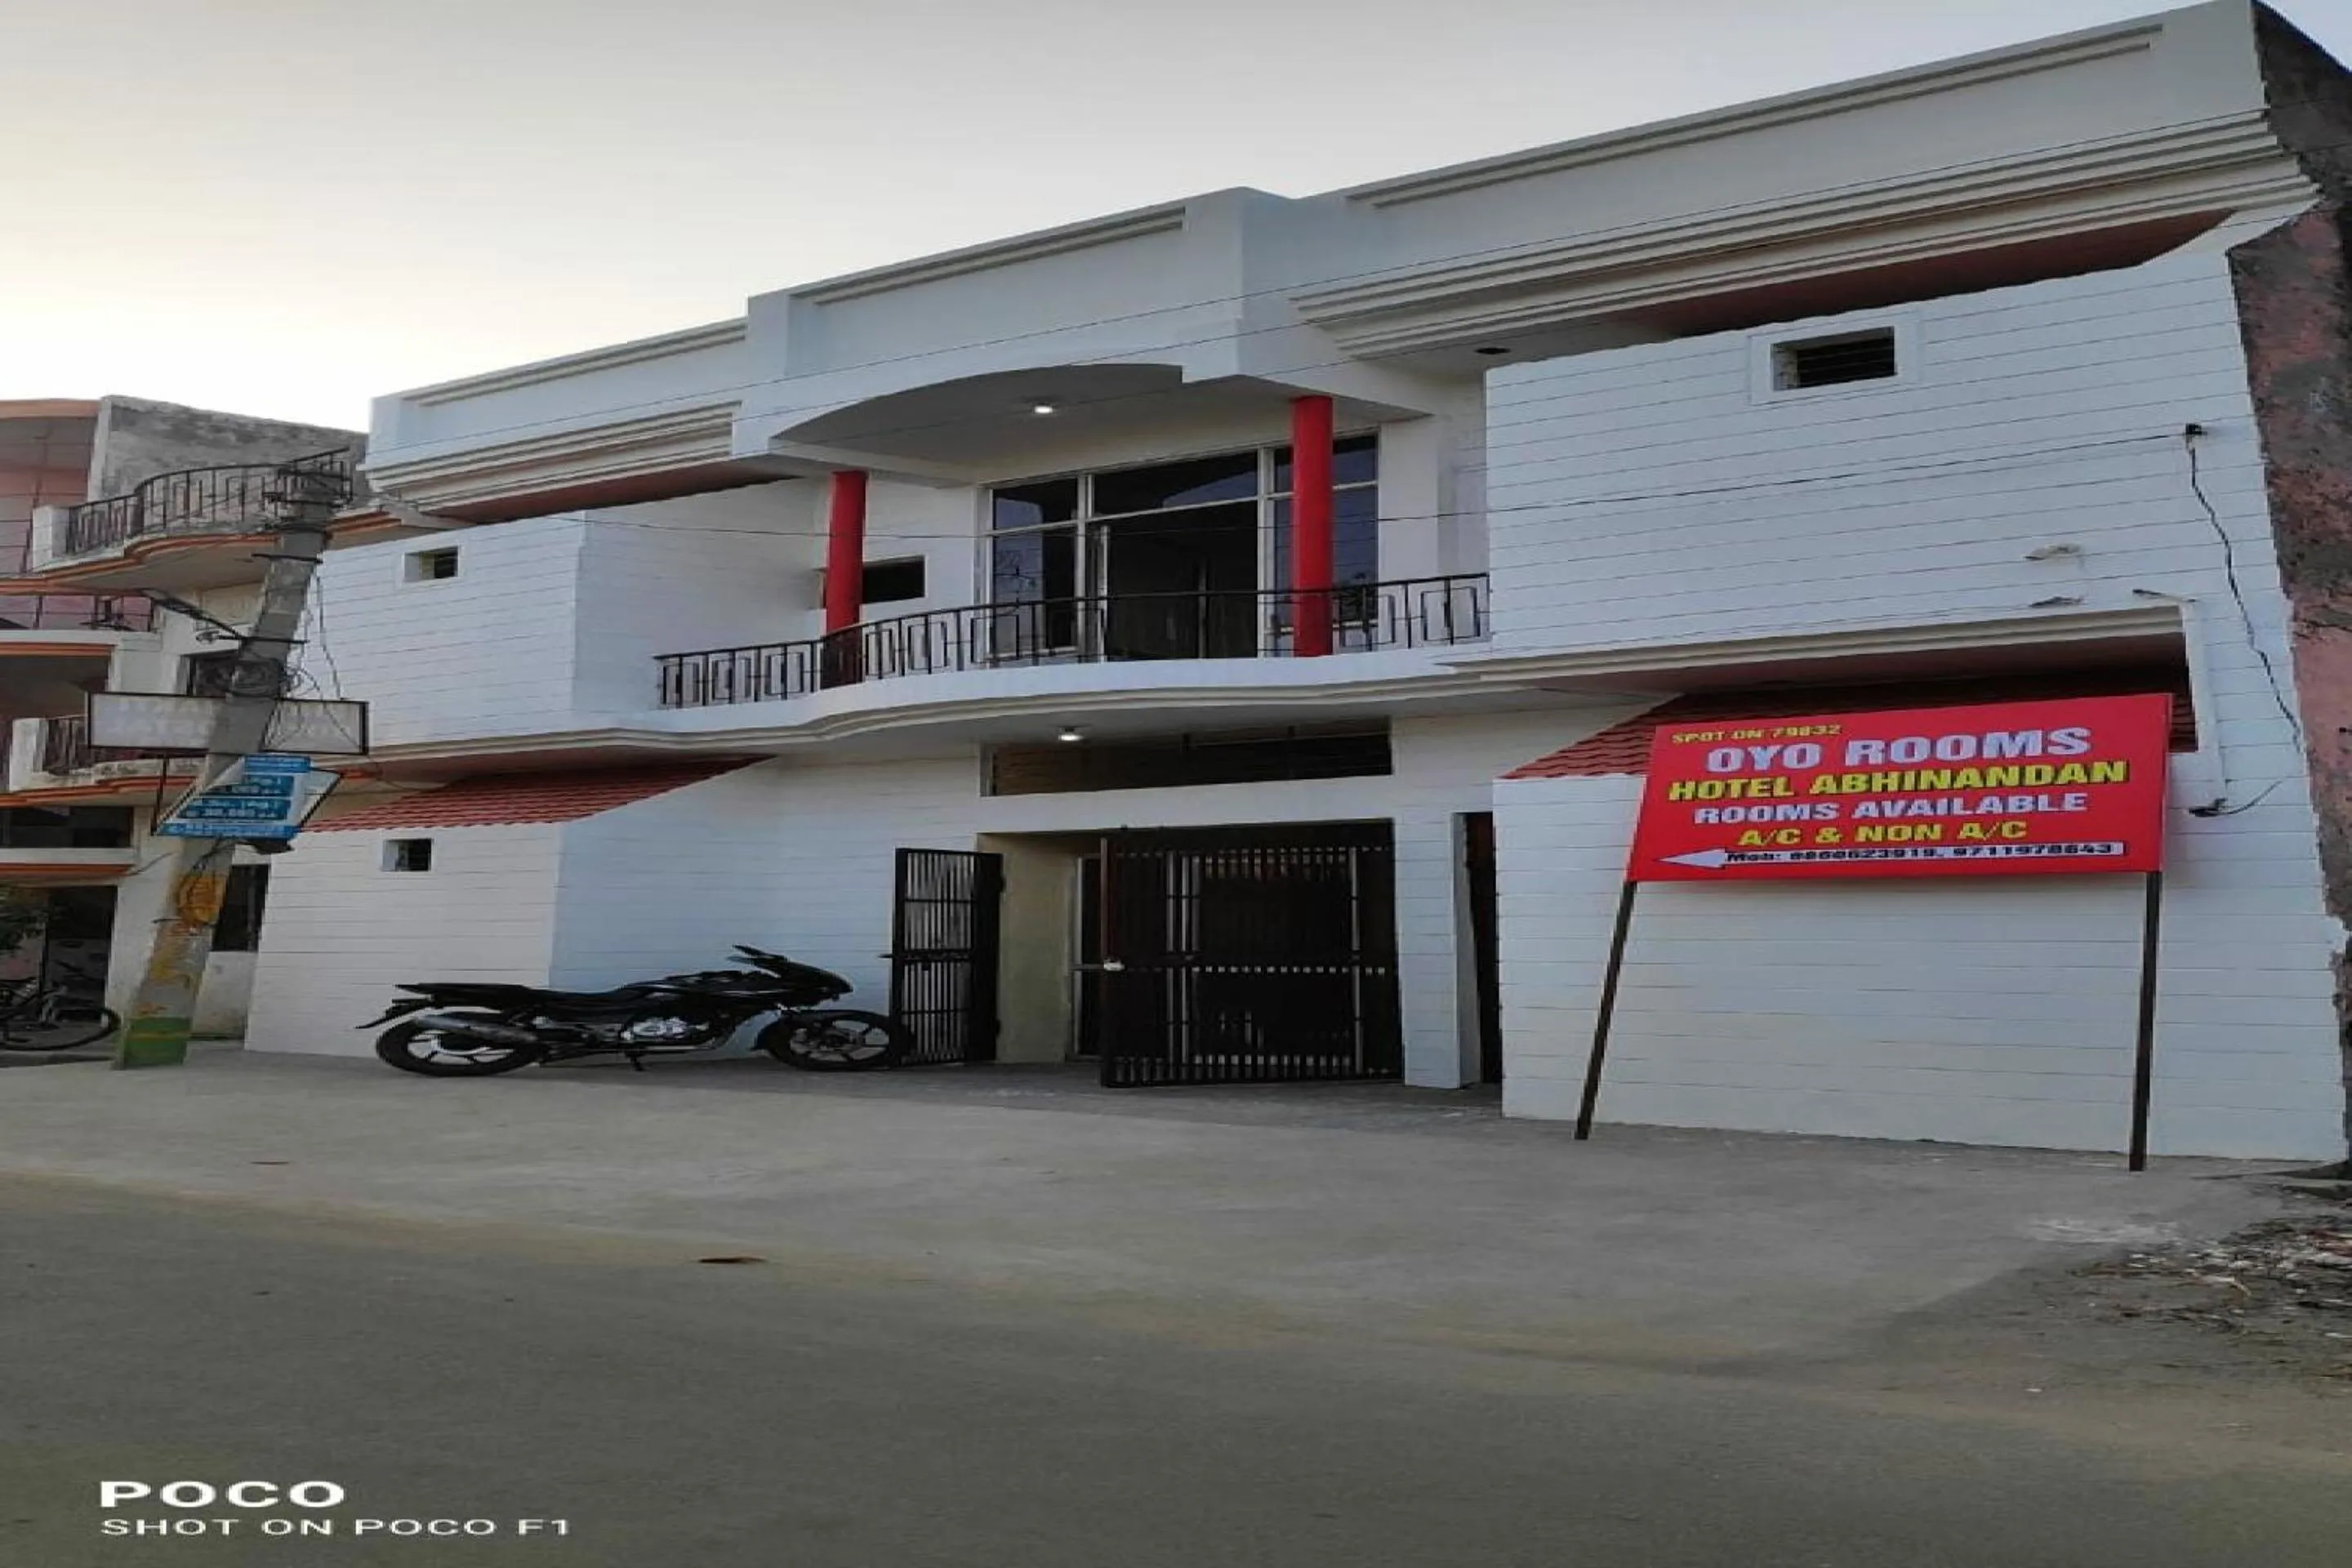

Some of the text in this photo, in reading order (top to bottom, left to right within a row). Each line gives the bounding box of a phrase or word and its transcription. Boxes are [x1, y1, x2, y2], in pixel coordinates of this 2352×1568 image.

[1672, 732, 1724, 744] SPOT
[1731, 728, 1762, 740] ON
[1707, 726, 2091, 773] OYO ROOMS
[1668, 760, 2128, 801] HOTEL ABHINANDAN
[1693, 792, 2089, 825] ROOMS AVAILABLE
[1737, 820, 2028, 846] A/C & NON A/C
[1726, 851, 1781, 862] Mob:
